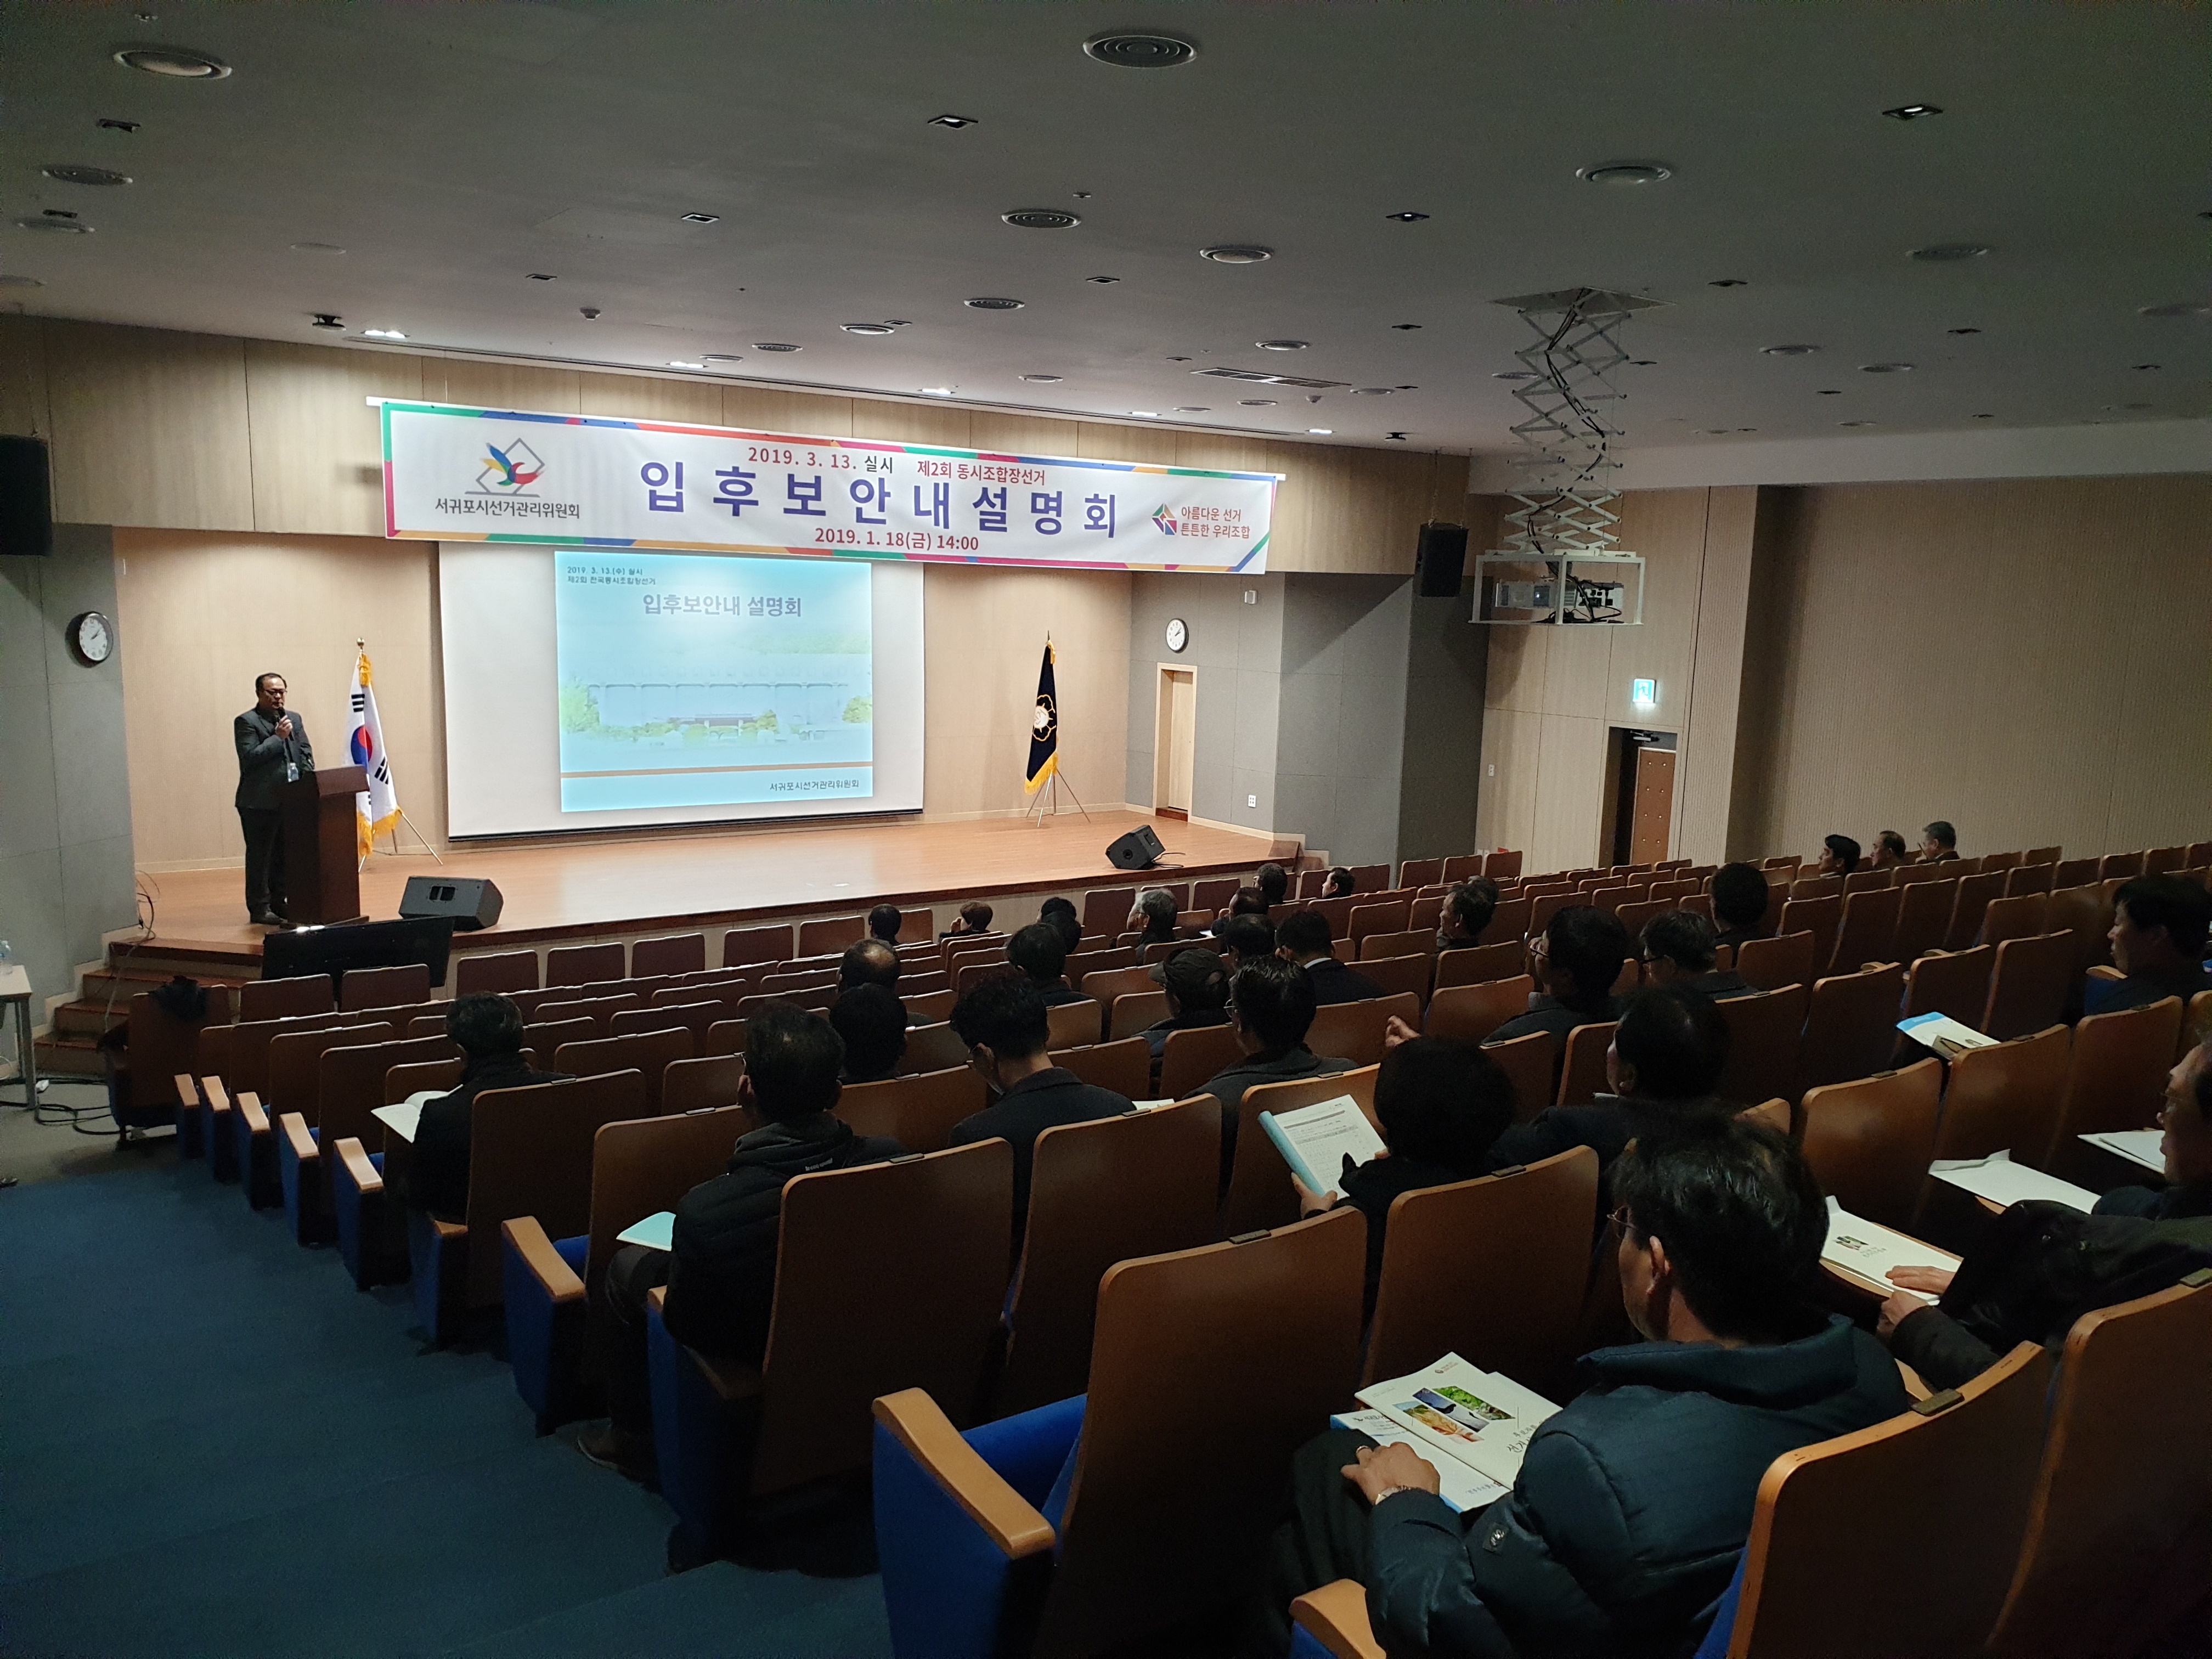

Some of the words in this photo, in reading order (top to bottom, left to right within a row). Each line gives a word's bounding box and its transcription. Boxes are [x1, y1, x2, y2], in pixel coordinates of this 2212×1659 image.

[748, 447, 799, 465] 2019.
[806, 452, 822, 467] 3.
[831, 454, 856, 470] 13.
[864, 455, 893, 474] 실시
[917, 460, 951, 479] 제2회
[957, 464, 1045, 486] 동시조합장선거
[435, 498, 580, 520] 서귀포시선거관리위원회
[1181, 506, 1220, 522] 아름다운
[1223, 509, 1242, 523] 선거
[815, 527, 861, 544] 2019.
[866, 531, 880, 545] 1.
[886, 532, 932, 551] 18(금)
[936, 535, 979, 551] 14:00
[1180, 522, 1210, 538] 튼튼한
[1212, 524, 1250, 539] 우리조합
[643, 594, 740, 616] 입후보안내
[747, 596, 801, 617] 설명회
[769, 779, 859, 792] 서귀포시선거관리위원회
